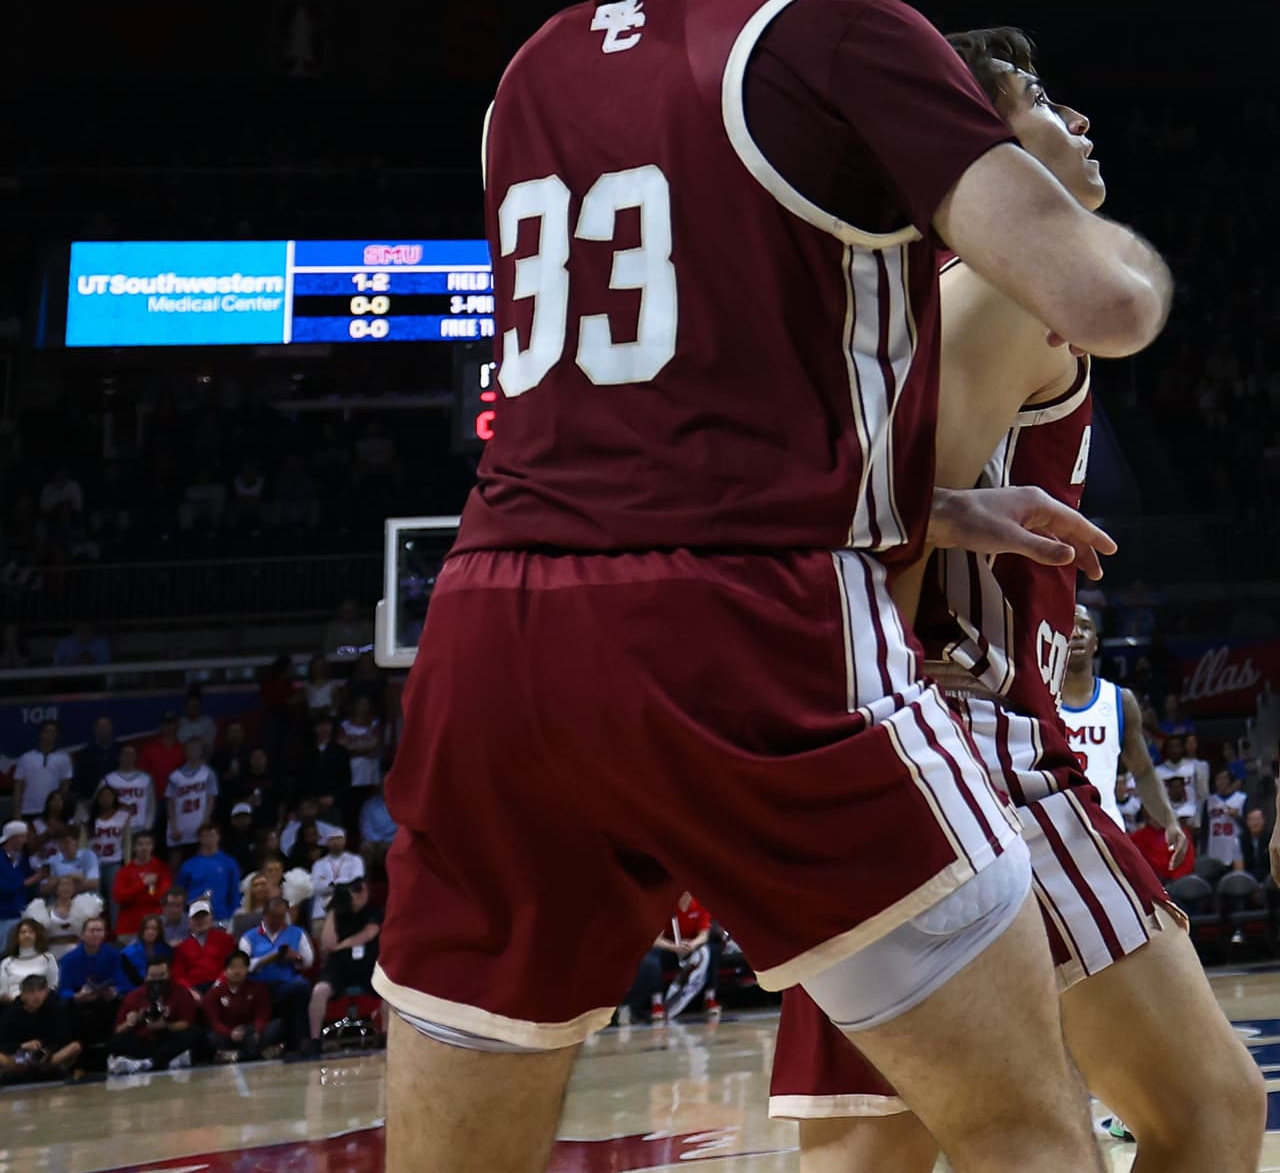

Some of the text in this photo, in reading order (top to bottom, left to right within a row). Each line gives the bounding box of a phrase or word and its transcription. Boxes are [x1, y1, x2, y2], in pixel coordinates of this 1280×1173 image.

[363, 244, 423, 265] SMU
[447, 273, 489, 291] FIELD
[498, 164, 678, 398] 33
[148, 295, 282, 313] Medical Center
[350, 295, 390, 315] 0-0
[349, 319, 389, 338] 0-0
[440, 318, 478, 337] FREE
[1065, 726, 1106, 744] MU
